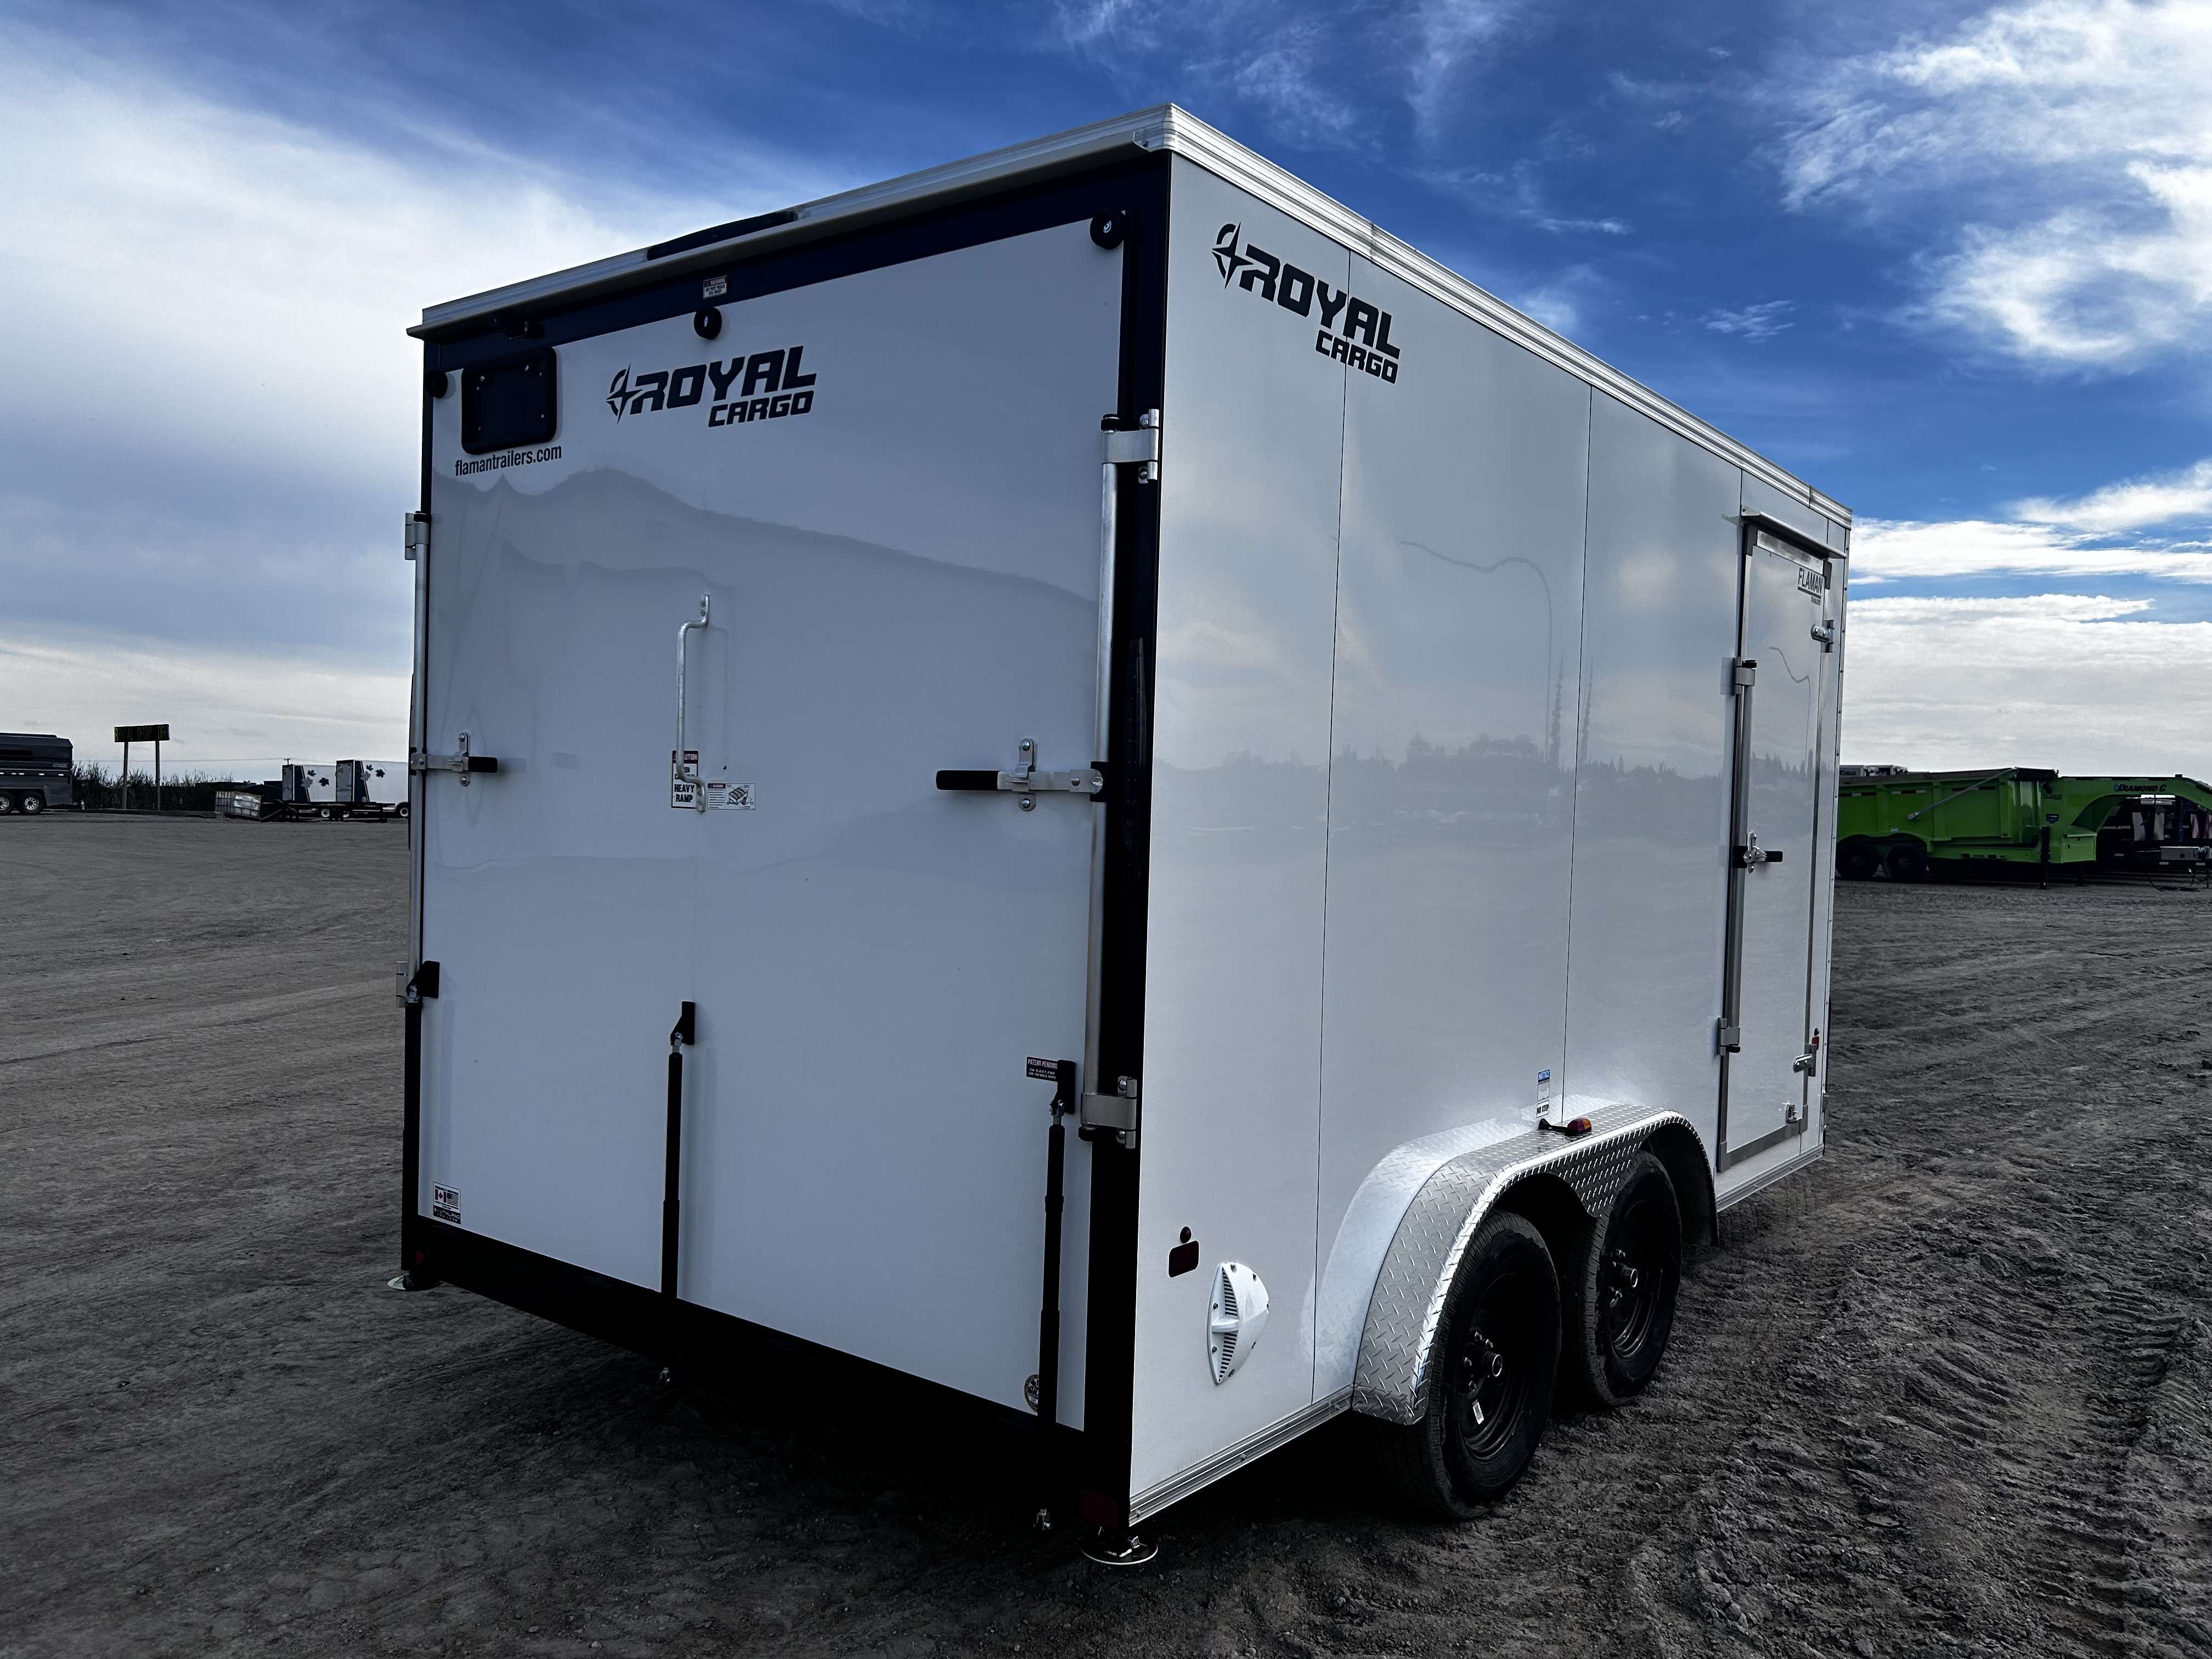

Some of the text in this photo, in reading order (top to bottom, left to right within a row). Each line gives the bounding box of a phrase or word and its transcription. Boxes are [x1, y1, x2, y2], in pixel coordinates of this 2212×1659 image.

[1239, 243, 1401, 360] ROYAL
[1316, 329, 1398, 384] CARGO
[630, 346, 817, 415] ROYAL
[708, 390, 815, 428] CARGO
[455, 445, 562, 476] flamantrailers.com
[1798, 567, 1823, 594] FLAMAN
[674, 783, 695, 793] HEAVY
[675, 794, 693, 803] RAMP
[2119, 784, 2168, 792] DIAMOND C
[1028, 1058, 1042, 1066] PATENT
